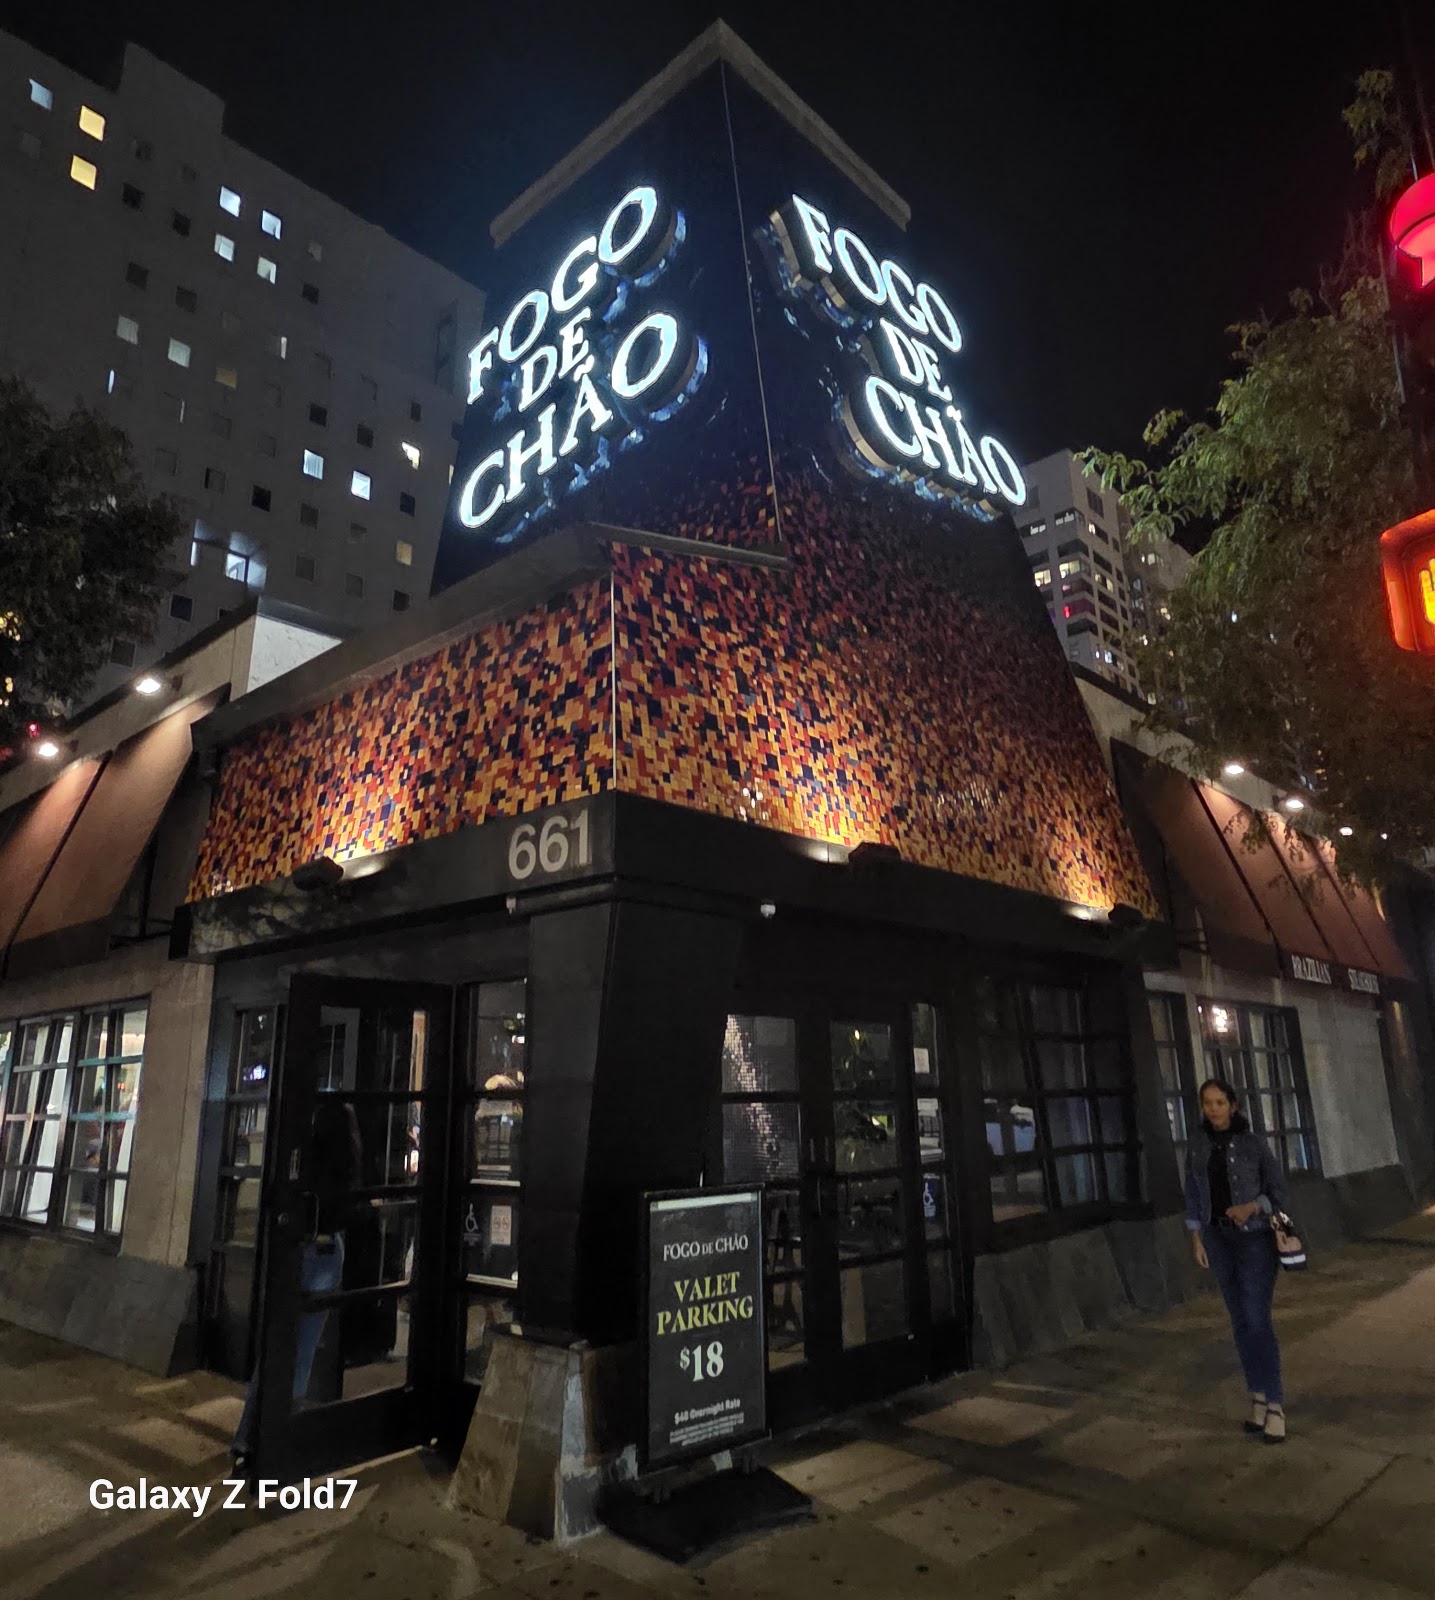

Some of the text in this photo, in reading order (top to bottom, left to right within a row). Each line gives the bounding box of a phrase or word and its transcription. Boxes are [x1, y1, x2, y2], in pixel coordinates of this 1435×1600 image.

[466, 186, 658, 405] FOGO
[792, 193, 962, 352] FOGO
[518, 307, 592, 413] DE
[879, 317, 952, 402] DE
[458, 311, 679, 529] CHÃO
[865, 373, 1027, 506] CHÃO
[508, 809, 589, 880] 661
[662, 1233, 749, 1262] FOGO DE CHÃO
[674, 1271, 740, 1303] VALET
[656, 1295, 754, 1335] PARKING
[679, 1341, 724, 1382] $18
